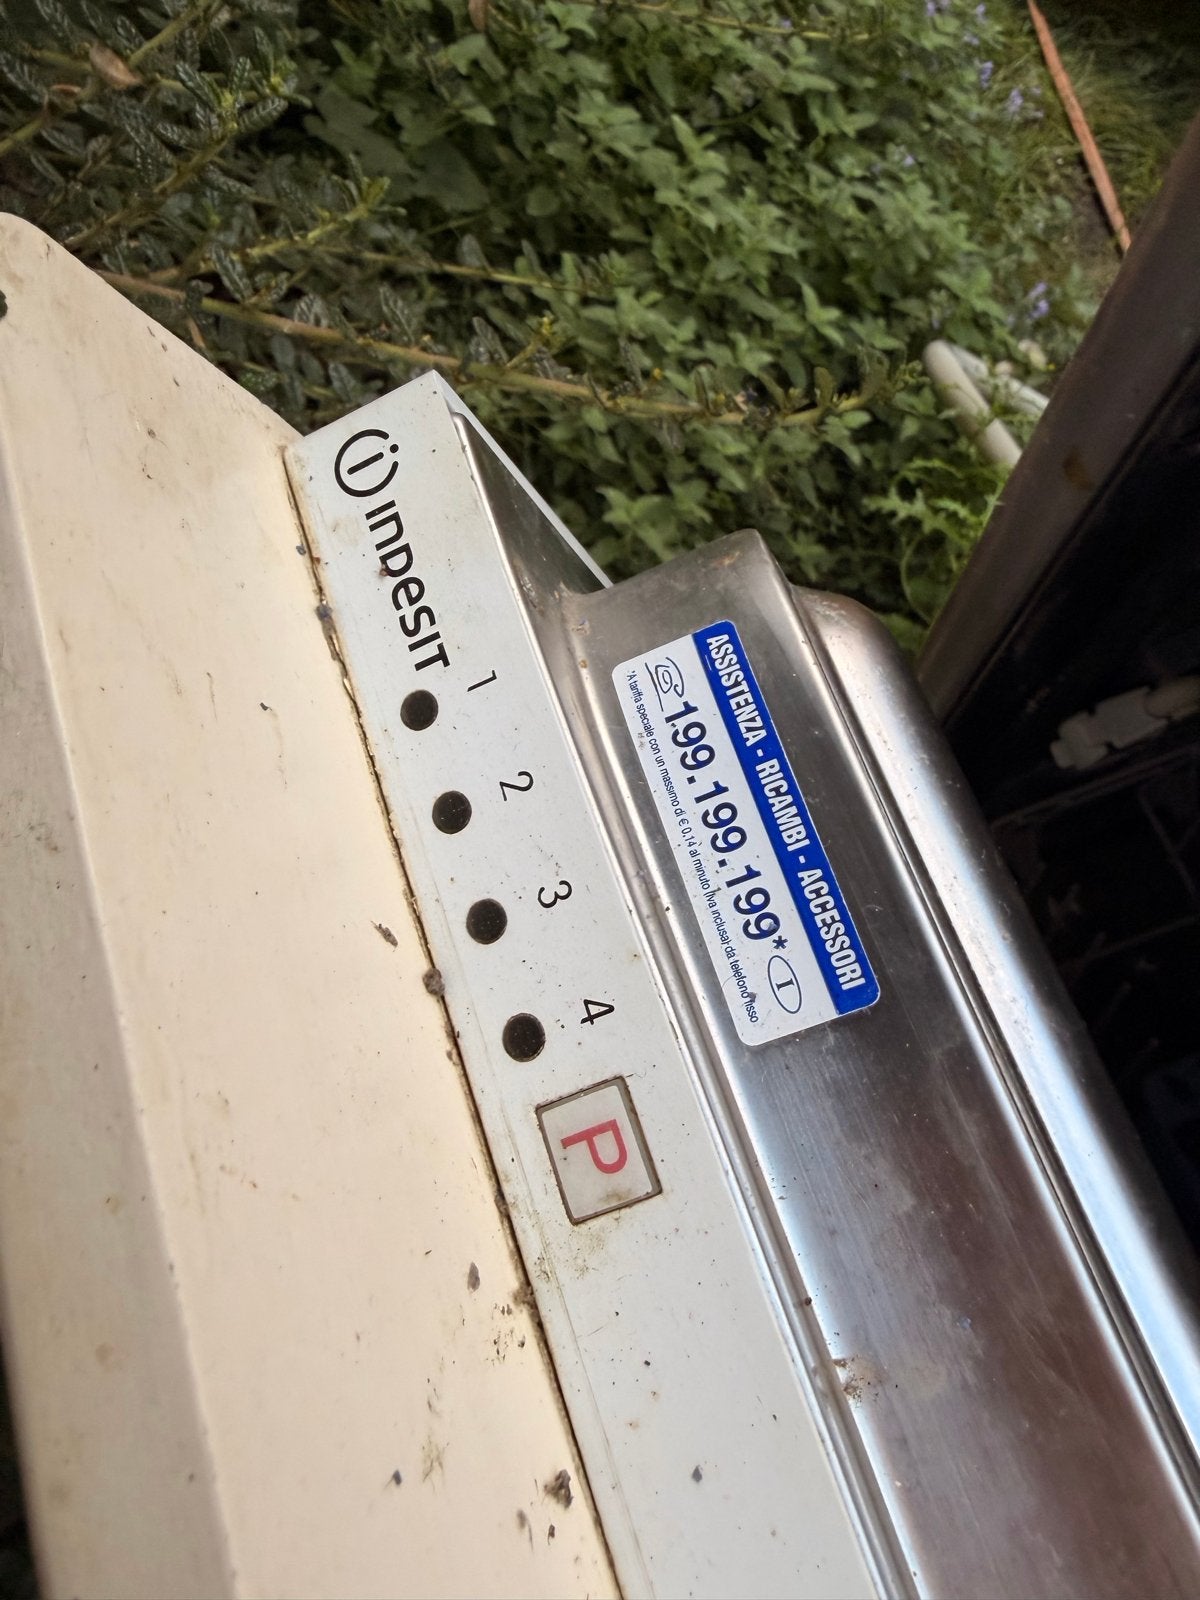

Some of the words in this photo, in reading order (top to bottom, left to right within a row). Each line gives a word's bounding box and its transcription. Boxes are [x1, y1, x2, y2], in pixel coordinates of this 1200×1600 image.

[468, 670, 497, 692] 1
[628, 680, 643, 703] tariffa
[636, 703, 655, 737] speciale
[648, 738, 661, 755] con
[654, 755, 665, 768] un
[500, 771, 533, 802] 2
[659, 768, 680, 807] massimo
[673, 807, 686, 817] di
[678, 818, 689, 827] €
[706, 634, 767, 747] ASSISTENZA
[755, 758, 810, 851] RICAMBI
[797, 868, 866, 990] ACCESSORI
[688, 849, 701, 858] al
[692, 858, 710, 890] minuto
[538, 881, 572, 909] 3
[724, 945, 736, 960] da
[728, 959, 753, 999] telefono
[581, 999, 614, 1025] 4
[743, 997, 759, 1023] fisso
[561, 1119, 628, 1175] P
